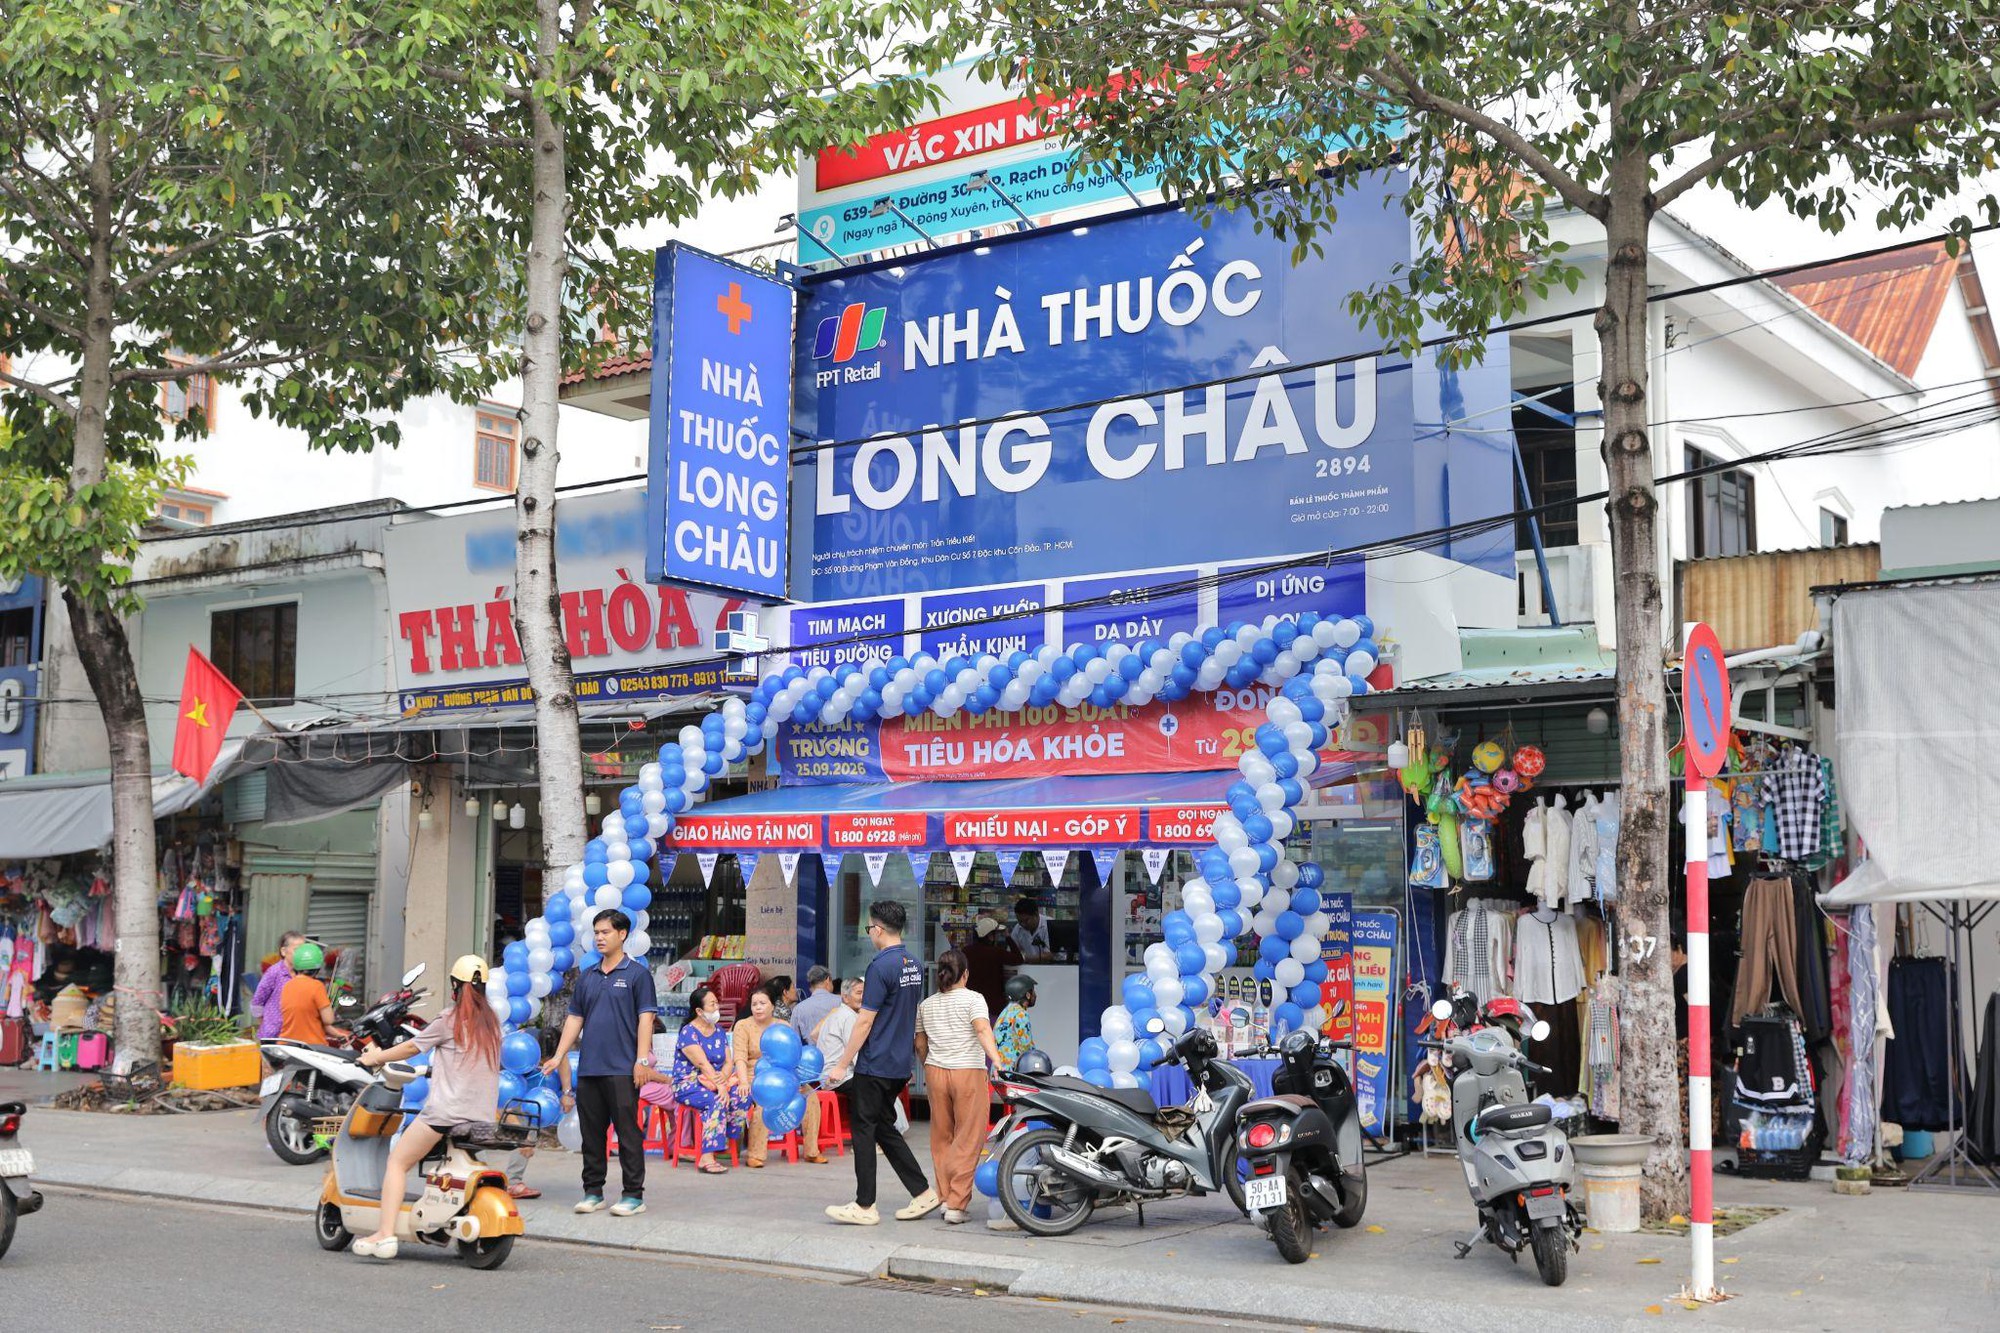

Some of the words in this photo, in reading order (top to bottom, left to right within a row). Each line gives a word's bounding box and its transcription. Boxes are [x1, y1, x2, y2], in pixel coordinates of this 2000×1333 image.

[883, 128, 946, 171] VẮC
[953, 118, 1006, 155] XIN
[899, 190, 947, 210] Đường
[1009, 165, 1048, 186] Rạch
[843, 227, 875, 244] (Ngay
[876, 218, 898, 235] ngã
[951, 198, 990, 217] Xuyên,
[1026, 182, 1050, 201] Khu
[1052, 180, 1085, 195] Công
[1041, 237, 1263, 347] THUỐC
[903, 285, 1025, 371] NHÀ
[701, 358, 764, 408] NHÀ
[815, 369, 840, 389] FPT
[844, 361, 881, 384] Retail
[679, 409, 780, 467] THUỐC
[816, 410, 1053, 517] LONG
[1085, 345, 1379, 480] CHÂU
[1315, 454, 1371, 478] 2894
[678, 461, 778, 521] LONG
[1289, 495, 1305, 506] BÁN
[1314, 490, 1340, 504] THUỐC
[1340, 487, 1365, 501] THÀNH
[1343, 506, 1360, 517] 7:00
[1366, 503, 1389, 515] 22:00
[674, 519, 778, 578] CHÂU
[1256, 579, 1275, 601] DỊ
[1281, 573, 1325, 595] ỨNG
[560, 567, 701, 658] HÒA
[926, 605, 987, 628] XƯƠNG
[807, 619, 832, 636] TIM
[837, 613, 886, 642] MẠCH
[1094, 623, 1121, 643] DẠ
[1125, 617, 1164, 639] DÀY
[834, 643, 893, 665] ĐƯỜNG
[985, 635, 1027, 655] KINH
[620, 676, 650, 692] 02543
[651, 675, 669, 690] 830
[1019, 704, 1058, 727] 100
[788, 735, 869, 758] TRƯƠNG
[904, 737, 965, 767] TIÊU
[973, 732, 1036, 764] HÓA
[1043, 724, 1125, 760] KHỎE
[852, 817, 868, 829] GỌI
[869, 817, 895, 826] NGAY:
[955, 814, 1008, 838] KHIẾU
[1014, 820, 1048, 842] NẠI
[1064, 814, 1110, 837] GÓP
[1114, 813, 1128, 836] Ý
[1177, 810, 1198, 823] GỌI
[672, 825, 709, 841] GIAO
[712, 821, 752, 841] HÀNG
[756, 820, 783, 845] TẬN
[787, 822, 814, 840] NƠI
[834, 830, 864, 843] 1800
[866, 830, 896, 842] 6928
[1155, 824, 1191, 838] 1800
[1355, 918, 1381, 929] THUỐC
[1366, 929, 1392, 940] CHÂU
[1336, 963, 1350, 982] GIÁ
[1251, 1180, 1279, 1194] 50-AA
[1249, 1191, 1282, 1208] 721.31
